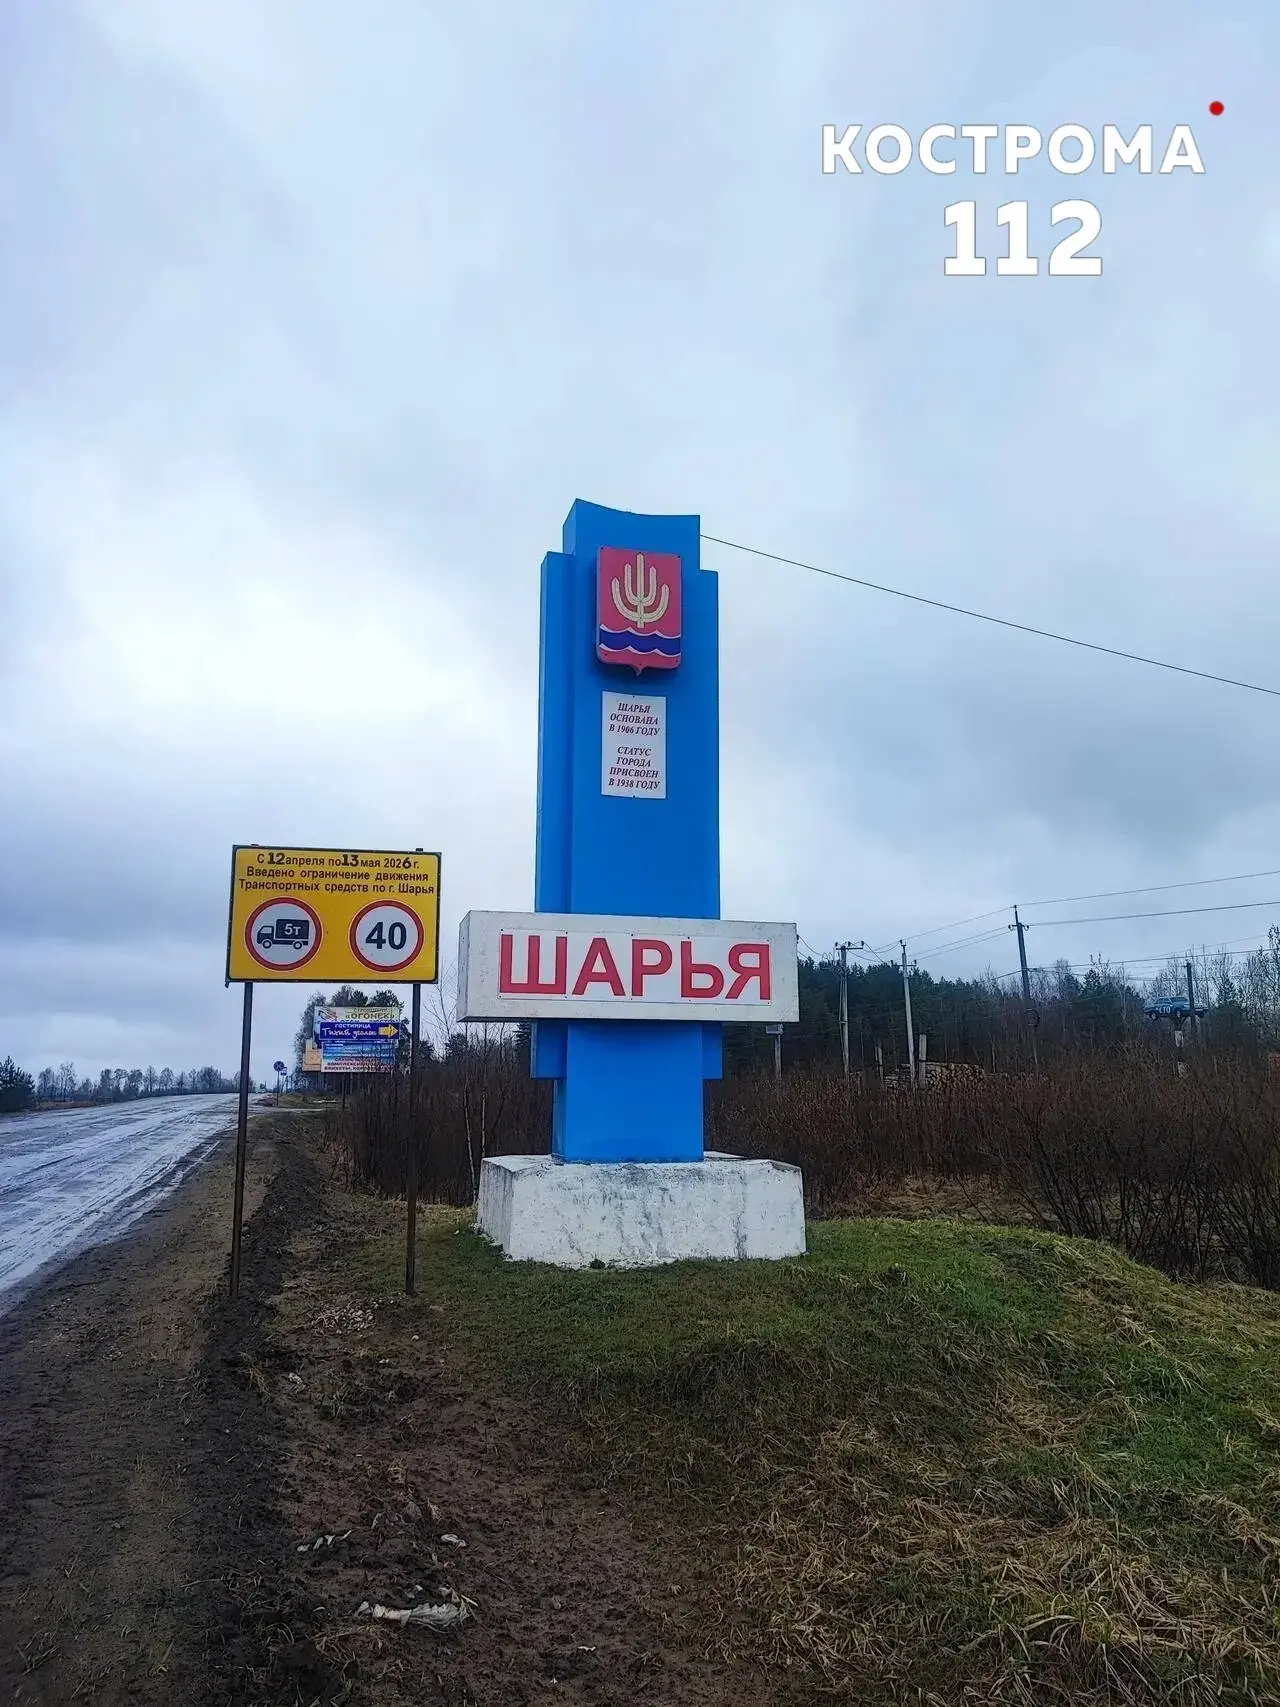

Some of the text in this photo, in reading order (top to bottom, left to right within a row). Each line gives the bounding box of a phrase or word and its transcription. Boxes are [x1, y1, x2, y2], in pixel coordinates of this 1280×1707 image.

[618, 702, 651, 714] ШАРЬЯ
[610, 713, 659, 725] ОСНОВАНА
[609, 724, 660, 737] В 1906 ГОДУ
[617, 746, 652, 756] СТАТУС
[616, 757, 651, 768] ГОРОДА
[609, 767, 659, 778] ПРИСВОЕН
[608, 778, 660, 791] В 1938 ГОДУ
[286, 856, 325, 867] апреля
[328, 858, 342, 866] по
[360, 859, 381, 868] мая
[383, 857, 412, 869] 2026
[413, 861, 420, 869] г.
[246, 866, 429, 882] Введено ограничение движения
[239, 878, 320, 892] Транспортных
[324, 883, 369, 893] средств
[398, 883, 435, 895] Шарья
[365, 921, 408, 950] 40
[499, 933, 771, 1001] ШАРЬЯ
